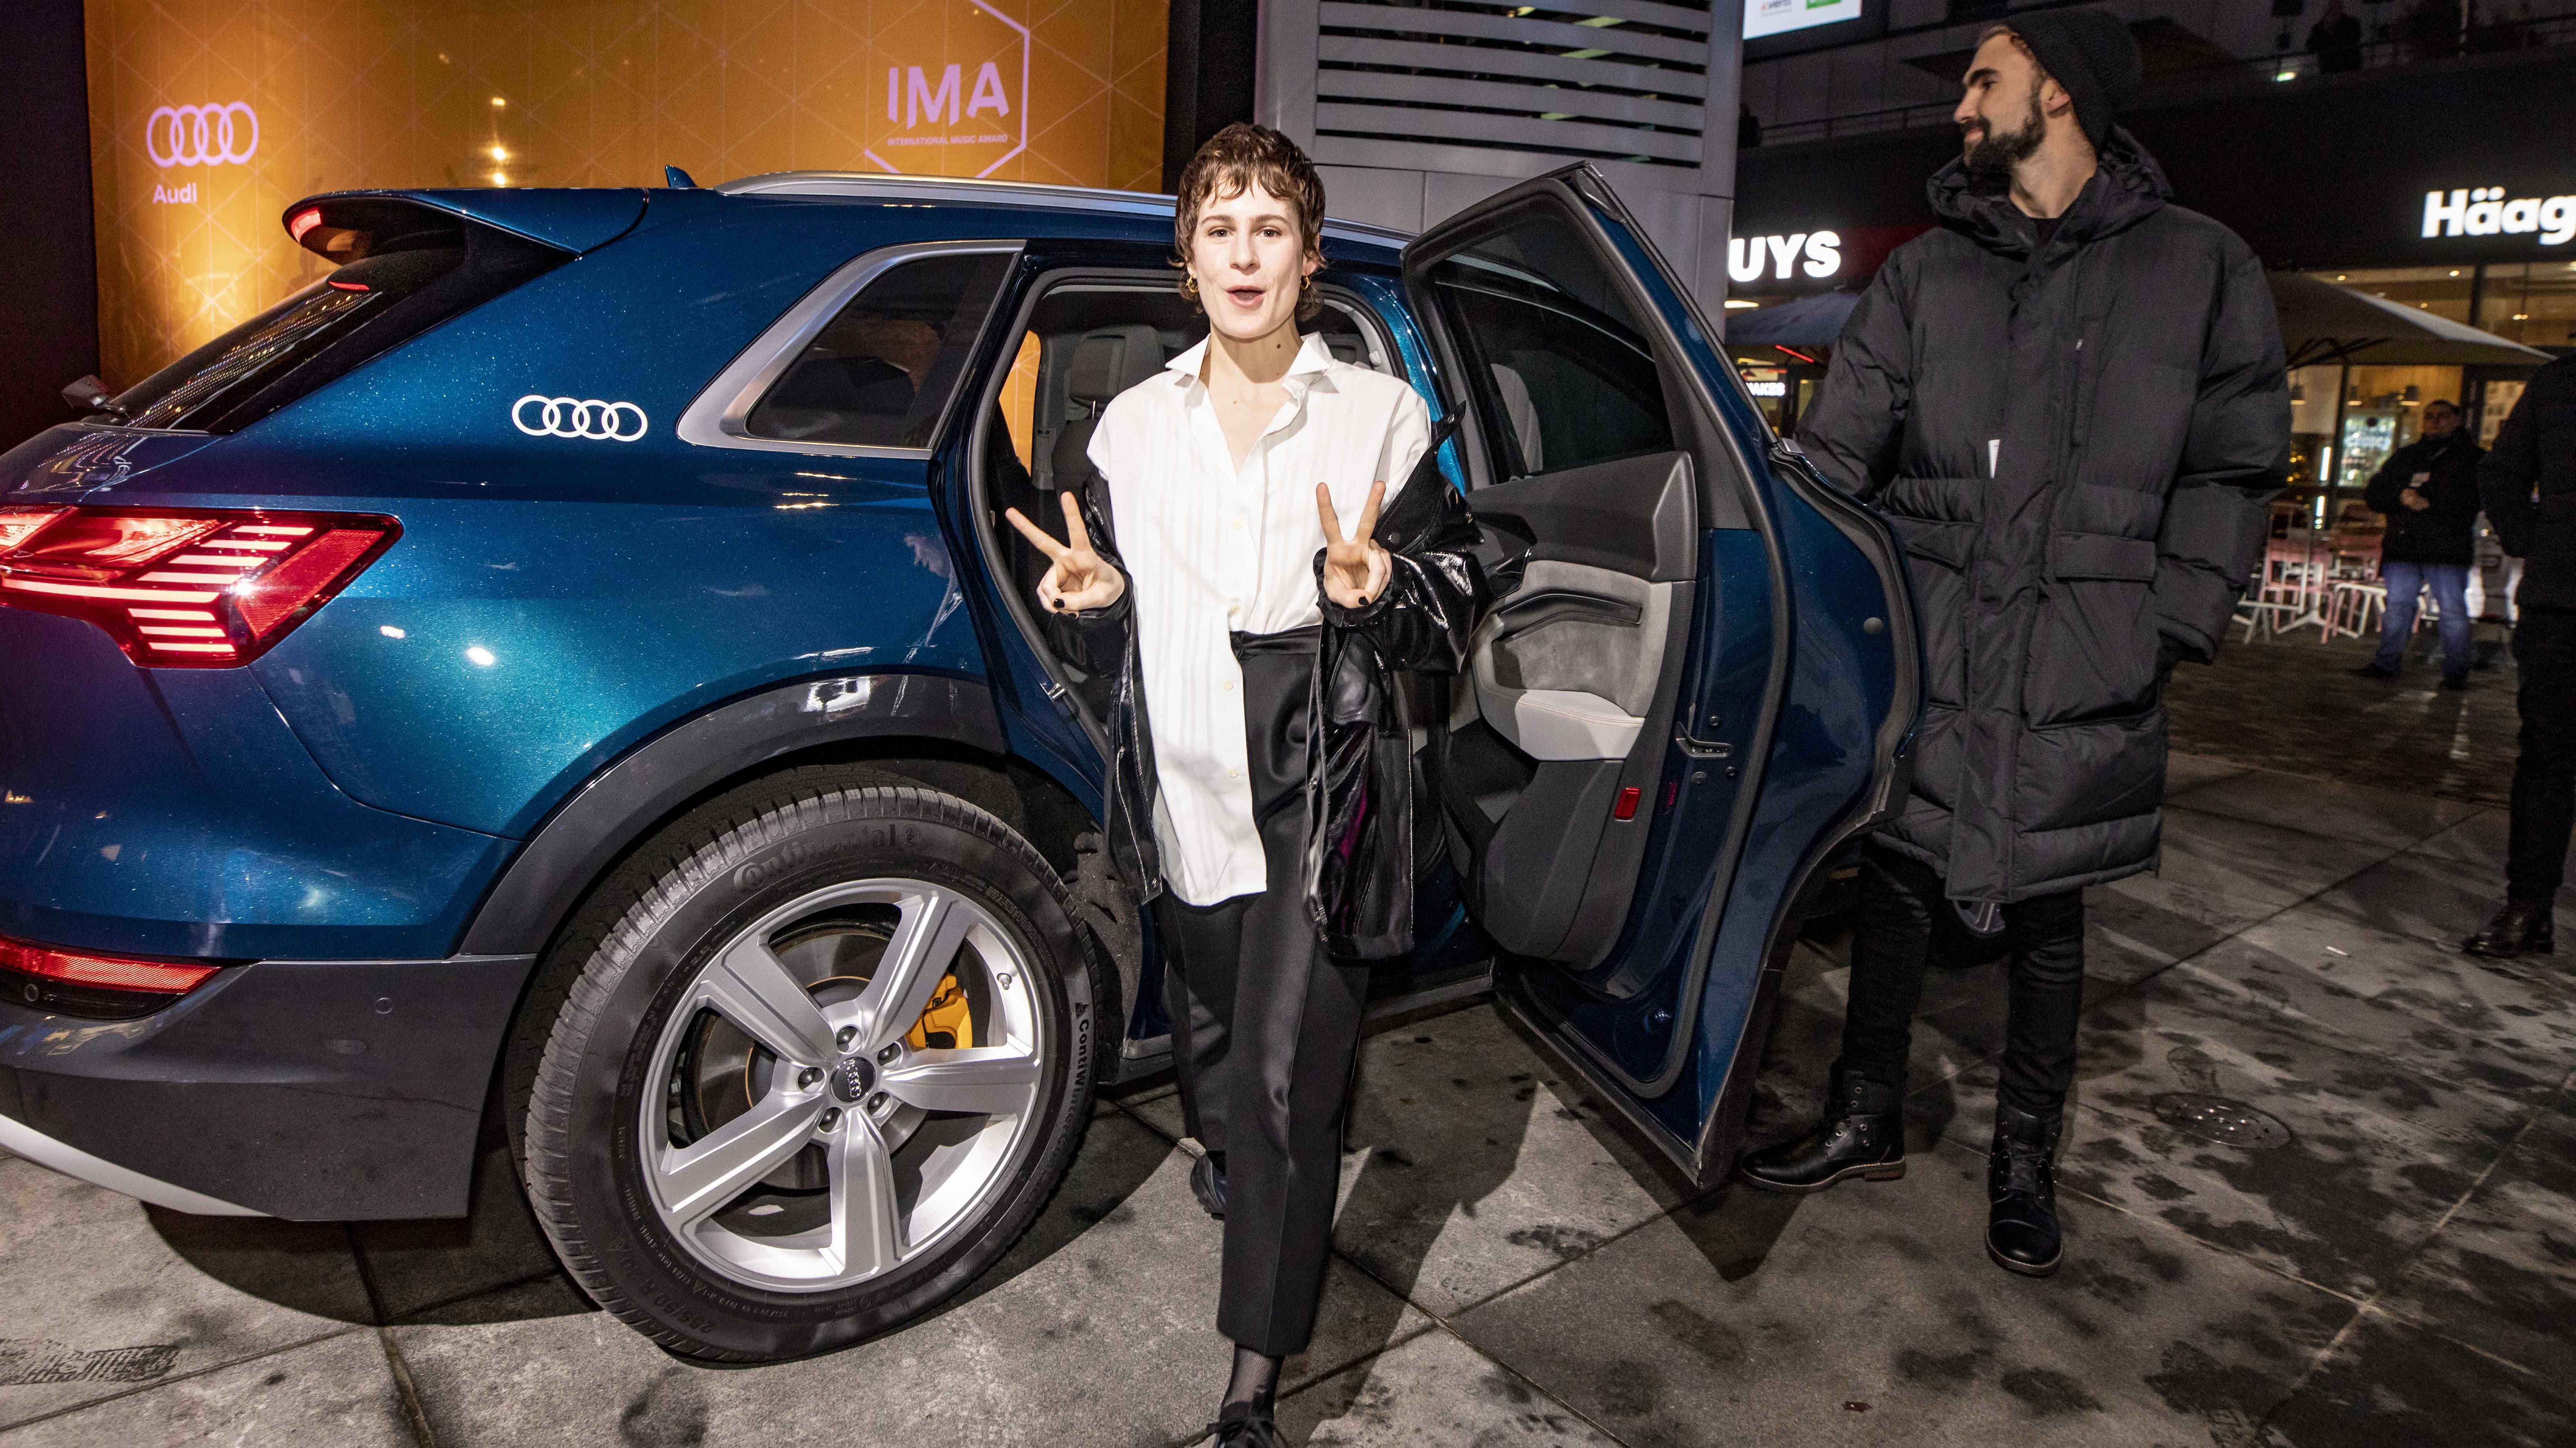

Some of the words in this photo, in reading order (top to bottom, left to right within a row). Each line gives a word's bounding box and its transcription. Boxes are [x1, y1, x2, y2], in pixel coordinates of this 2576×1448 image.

[888, 62, 1009, 130] IMA
[887, 137, 948, 146] INTERNATIONAL
[978, 134, 1008, 143] AWARD
[153, 182, 198, 204] Audi
[2421, 186, 2576, 245] Häag
[1728, 231, 1841, 282] UYS
